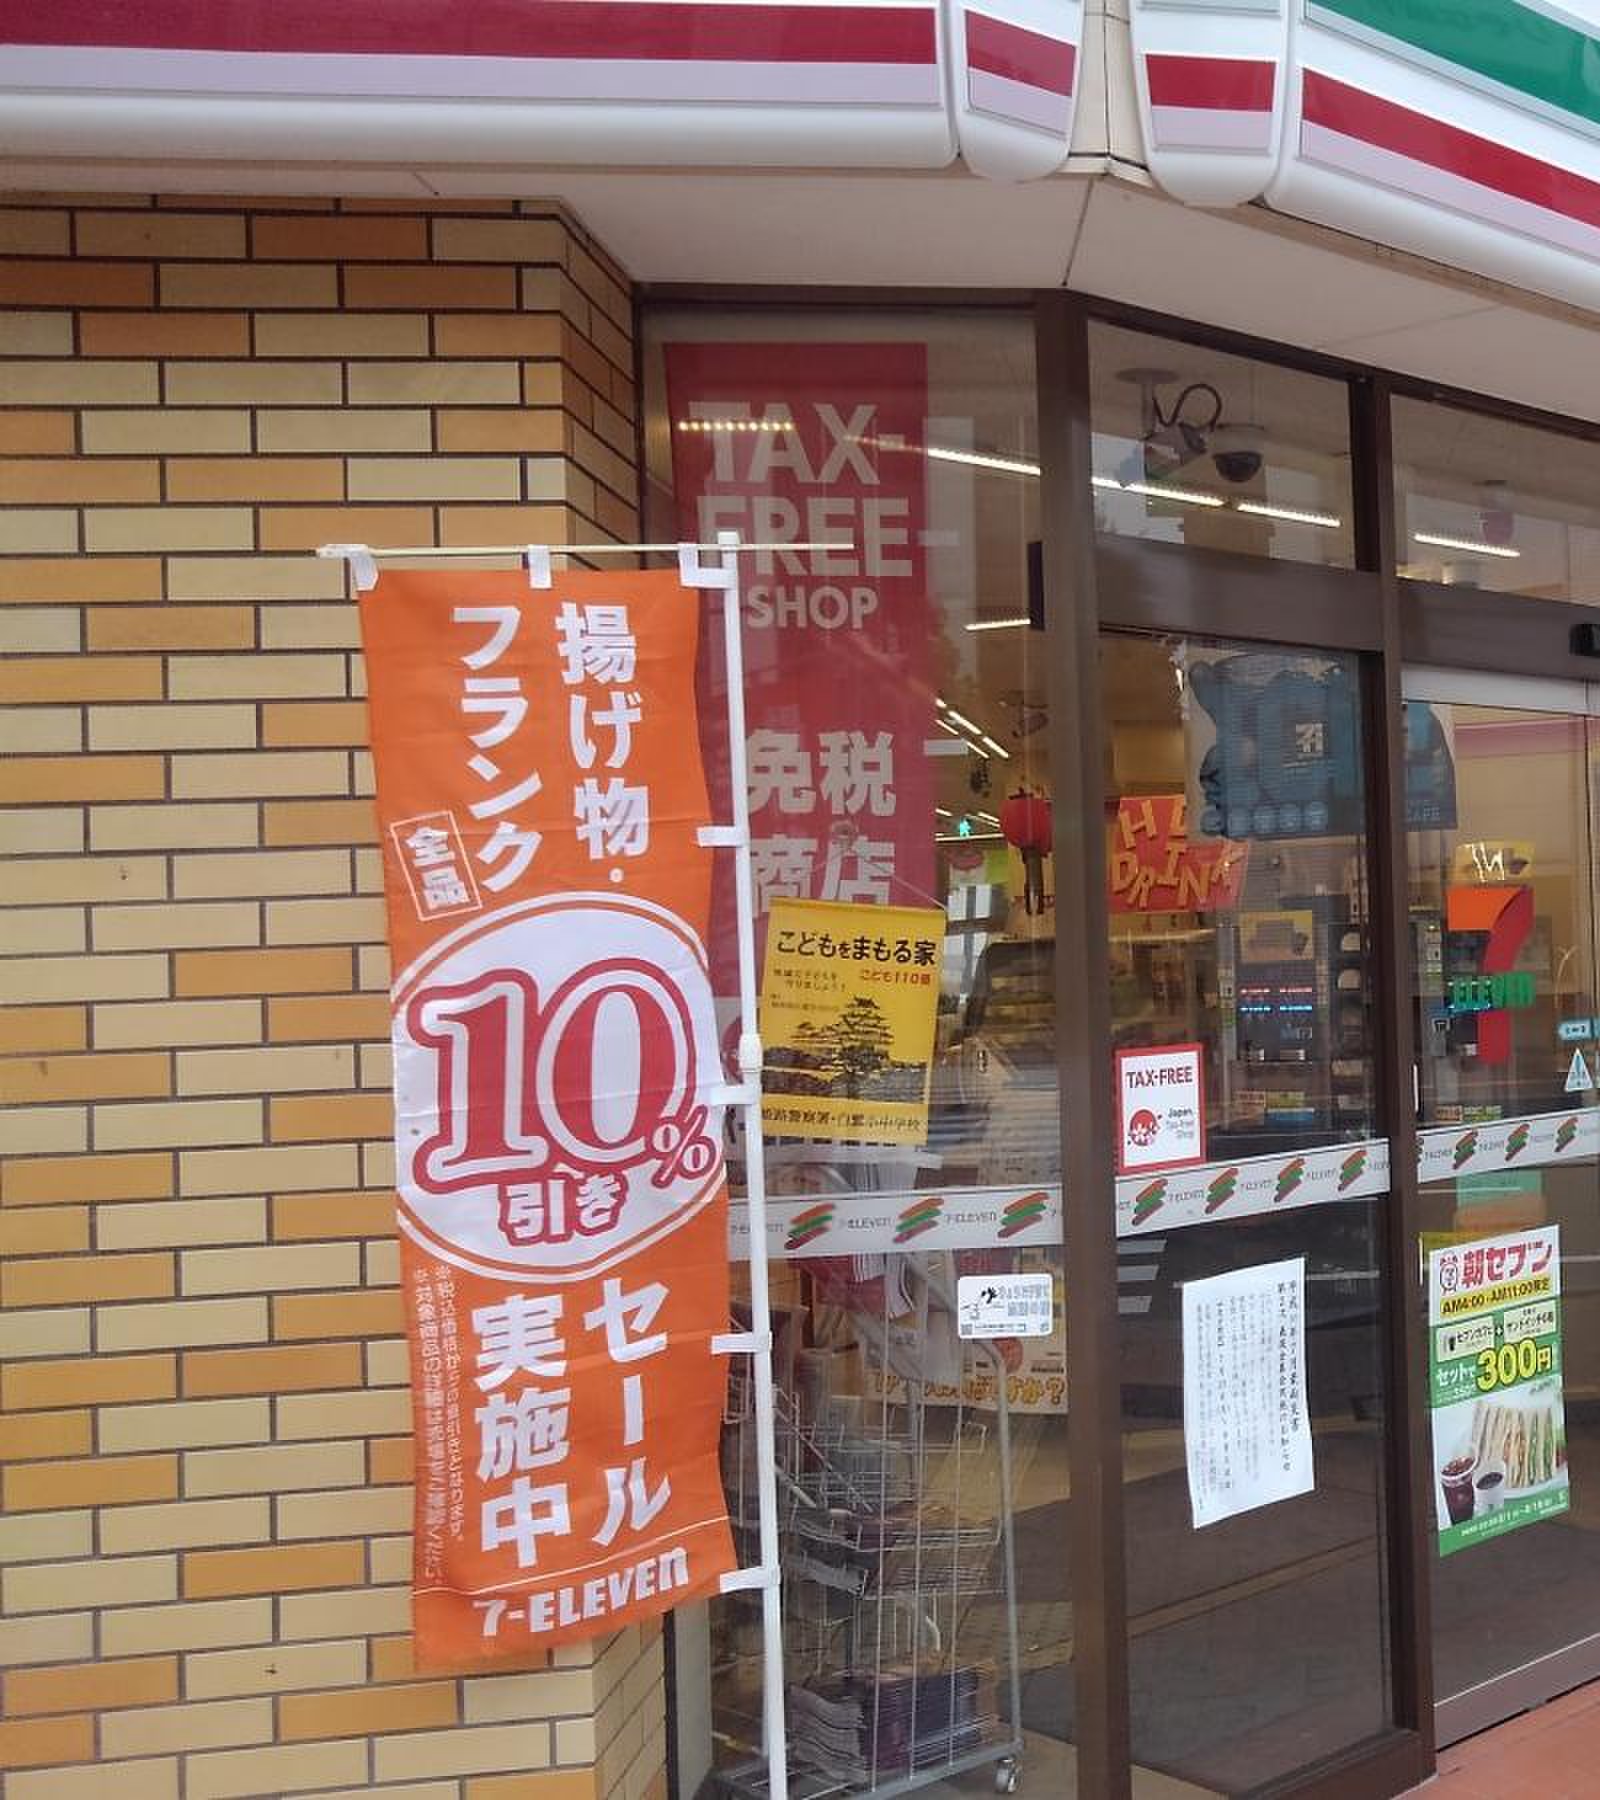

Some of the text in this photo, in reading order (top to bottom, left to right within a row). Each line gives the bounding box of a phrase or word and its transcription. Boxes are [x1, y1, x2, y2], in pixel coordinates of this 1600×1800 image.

[696, 495, 913, 577] FREE
[749, 585, 879, 630] SHOP
[453, 605, 543, 893] フランク
[745, 728, 897, 815] 免税
[406, 827, 471, 911] 全品
[777, 931, 937, 966] こどもをまもる家
[406, 957, 720, 1195] 10%
[499, 1164, 628, 1247] 引き
[1462, 1241, 1553, 1289] 朝セブン
[1477, 1337, 1553, 1392] 300円
[470, 1293, 571, 1569] 実施中
[584, 1278, 671, 1547] セール
